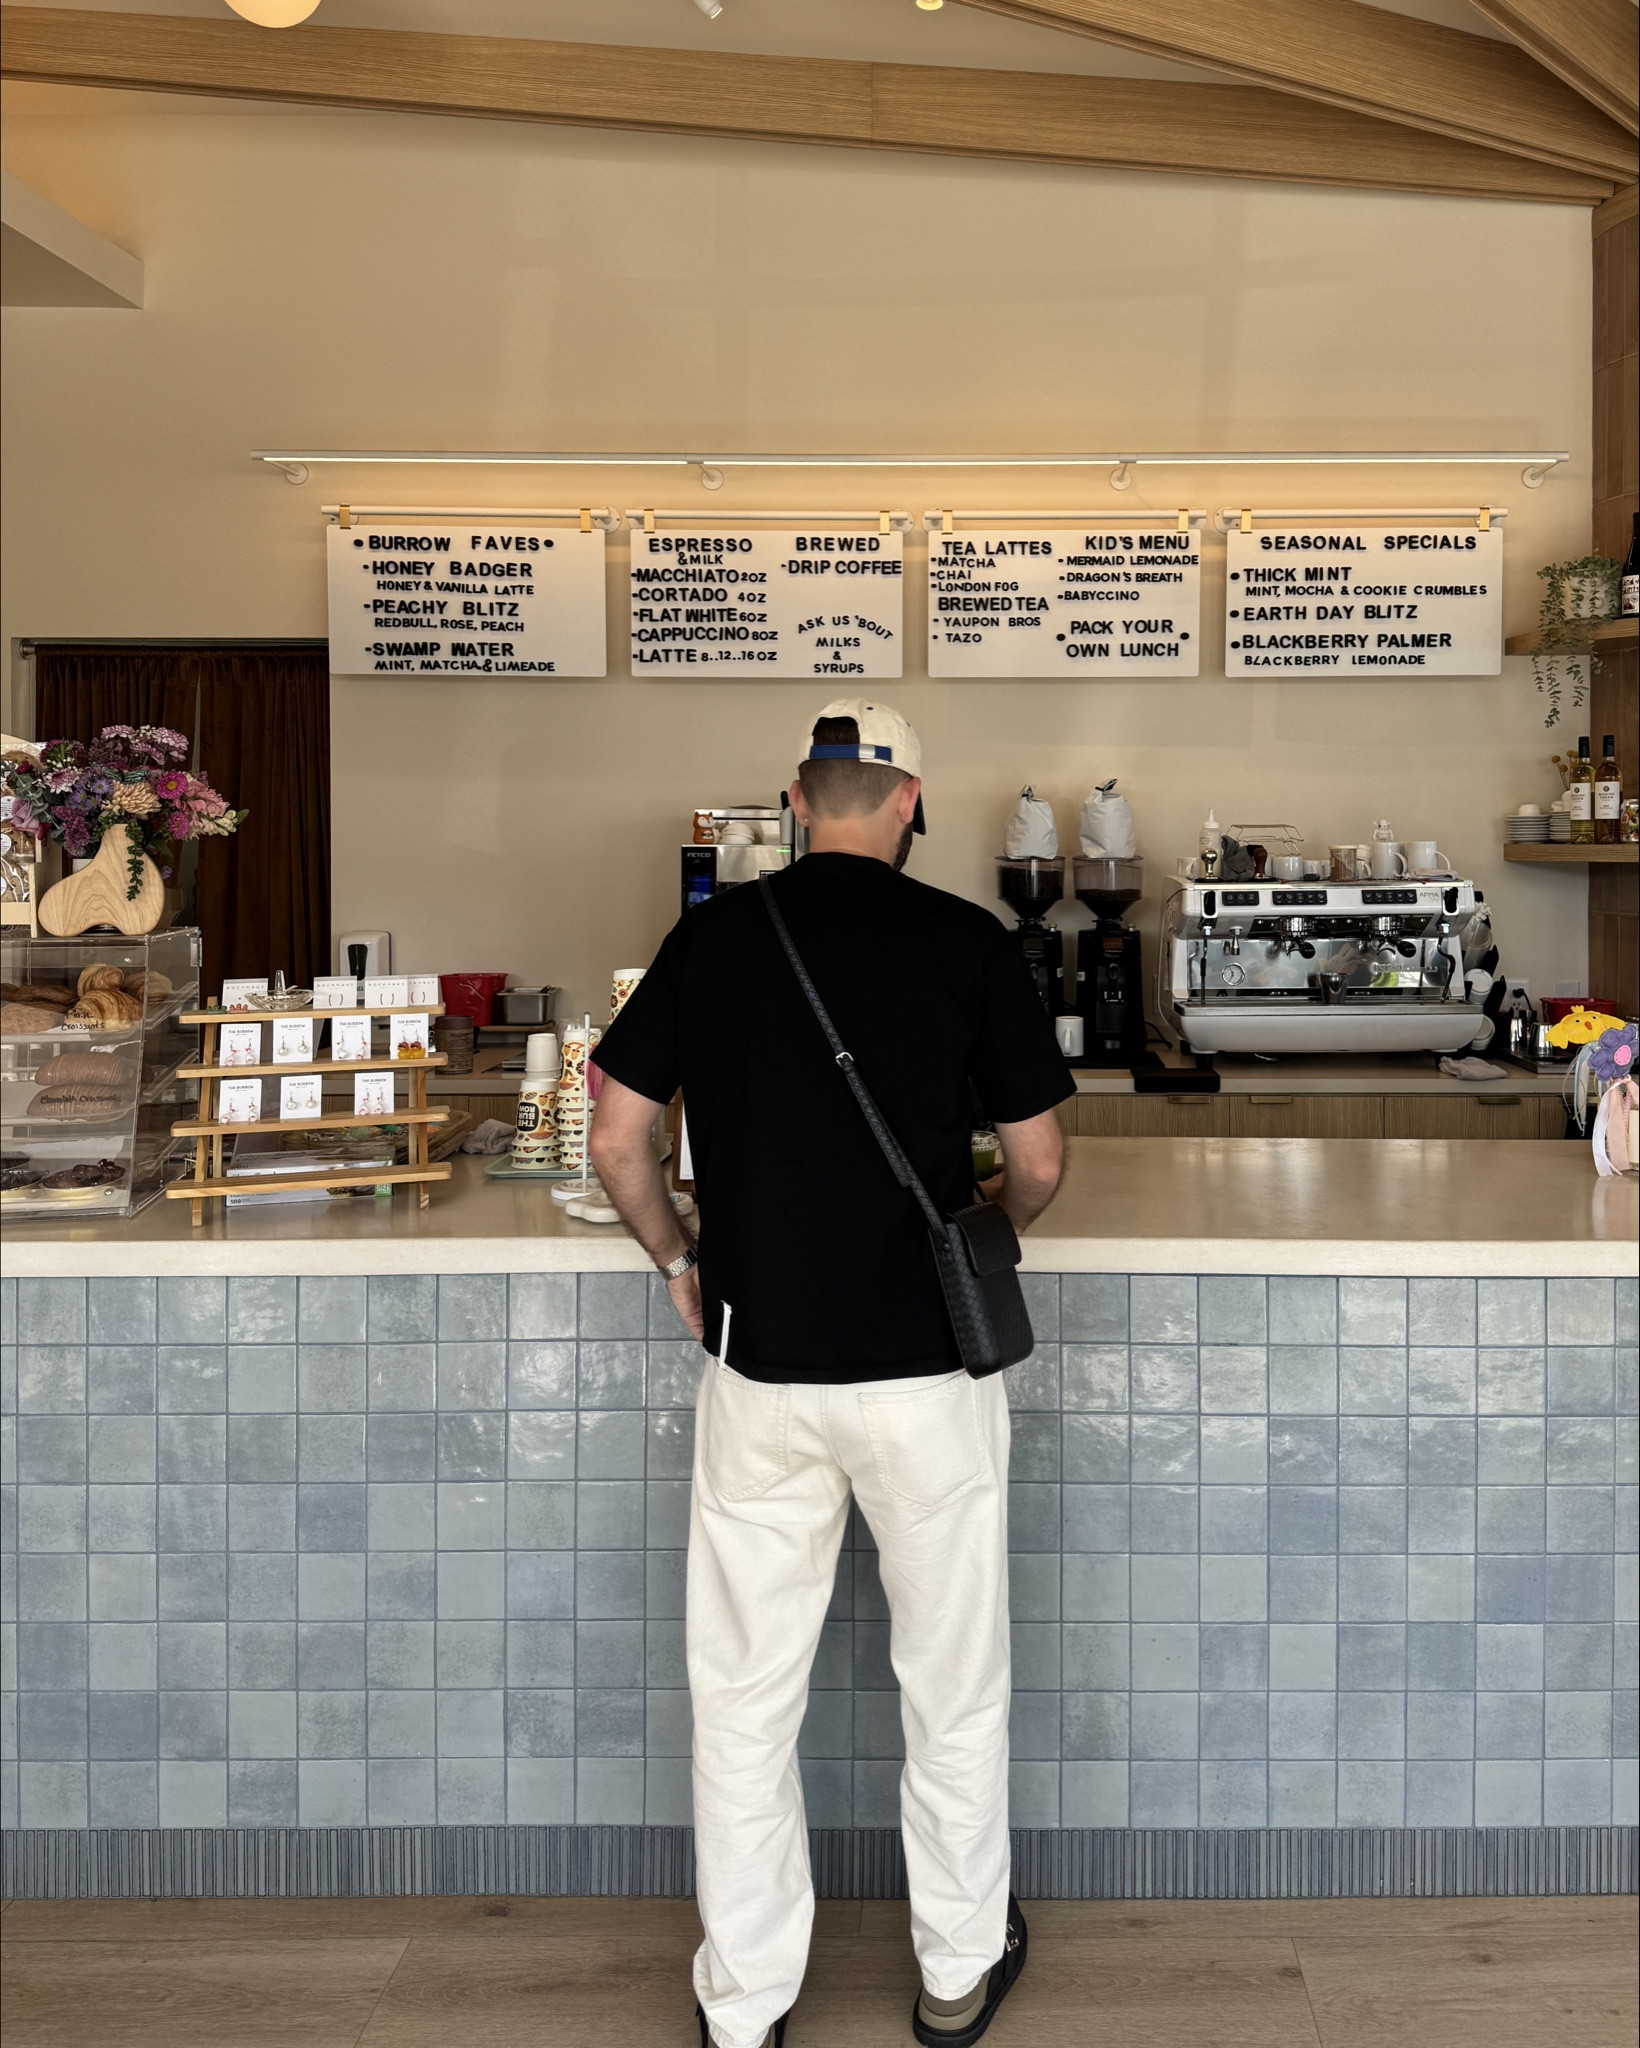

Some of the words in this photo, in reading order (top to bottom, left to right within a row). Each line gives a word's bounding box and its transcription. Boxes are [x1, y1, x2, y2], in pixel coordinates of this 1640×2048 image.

[369, 536, 450, 551] BURROW
[472, 536, 539, 551] FAVES
[649, 538, 752, 553] ESPRESSO
[796, 537, 879, 551] BREWED
[942, 542, 976, 555] TEA
[986, 541, 1051, 555] LATTES
[1086, 536, 1133, 550] KID'S
[1140, 536, 1189, 549] MENU
[1261, 536, 1366, 550] SEASONAL
[1384, 535, 1476, 549] SPECIALS
[789, 560, 830, 574] DRIP
[835, 561, 901, 574] COFFEE
[939, 557, 995, 567] MATCHA
[1067, 556, 1124, 565] MERMAID
[1131, 555, 1198, 565] LEMONADE
[373, 561, 435, 575] HONEY
[450, 561, 532, 577] BADGER
[637, 569, 739, 583] MACCHIATO
[937, 570, 970, 580] CHAI
[1244, 568, 1296, 582] THICK
[1305, 567, 1351, 581] MINT
[1136, 573, 1182, 582] BREATH
[377, 580, 421, 591] HONEY
[424, 581, 433, 590] &
[435, 582, 488, 593] VANILLA
[495, 585, 534, 595] LATTE
[939, 582, 990, 592] LONDON
[995, 582, 1018, 591] FOG
[1246, 586, 1280, 597] MINT,
[1286, 586, 1333, 595] MOCHA
[1341, 586, 1349, 595] &
[1354, 586, 1406, 595] COOKIE
[1414, 585, 1487, 595] CRUMBLES
[638, 588, 727, 601] CORTADO
[1065, 591, 1139, 600] BABYCCINO
[373, 600, 448, 614] PEACHY
[463, 601, 518, 616] BLITZ
[939, 597, 1012, 611] BREWED
[1015, 597, 1049, 611] TEA
[640, 608, 681, 622] FLAT
[686, 608, 737, 622] WHITE
[1244, 606, 1306, 621] EARTH
[1317, 606, 1354, 620] DAY
[1365, 605, 1417, 618] BLITZ
[441, 619, 477, 631] ROSE,
[481, 621, 524, 632] PEACH
[799, 616, 824, 633] ASK
[833, 616, 849, 625] US
[944, 617, 999, 626] YAUPON
[1009, 617, 1040, 626] BROS
[1071, 621, 1113, 634] PACK
[1123, 620, 1173, 633] YOUR
[638, 627, 749, 642] CAPPUCCINO
[946, 633, 981, 642] TAZO
[1243, 634, 1368, 648] BLACKBERRY
[1378, 634, 1451, 647] PALMER
[373, 642, 440, 656] SWAMP
[452, 642, 514, 656] WATER
[816, 638, 860, 647] MILKS
[639, 649, 697, 662] LATTE
[833, 651, 841, 660] &
[1067, 644, 1109, 657] OWN
[1121, 643, 1178, 656] LUNCH
[374, 660, 414, 671] MINT,
[495, 661, 555, 671] LIMEADE
[1245, 655, 1339, 666] BLACKBERRY
[814, 663, 864, 673] SYRUPS
